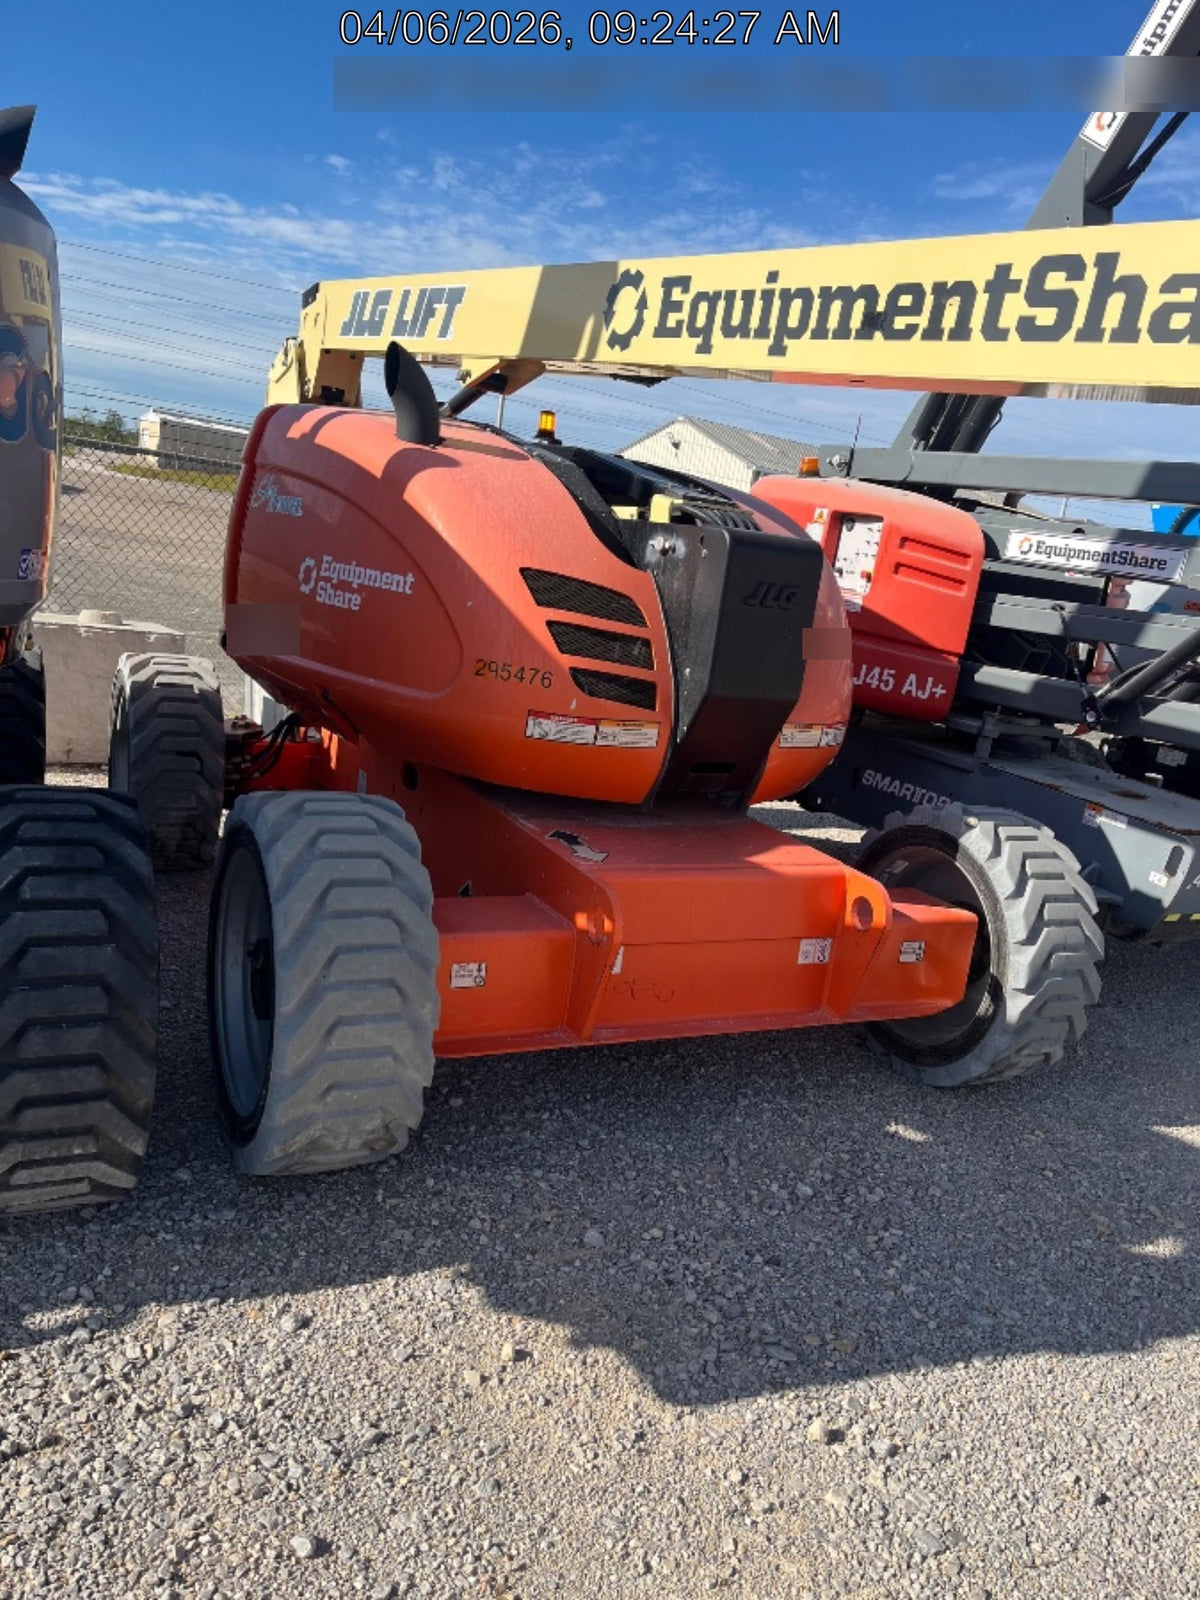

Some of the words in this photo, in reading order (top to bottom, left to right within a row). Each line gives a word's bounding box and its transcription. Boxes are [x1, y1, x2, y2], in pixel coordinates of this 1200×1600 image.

[339, 288, 394, 337] JLG
[390, 284, 468, 340] LIFT
[1034, 540, 1168, 571] EquipmentShare
[319, 553, 415, 595] Equipment
[315, 580, 362, 611] Share
[474, 658, 554, 689] 295476
[900, 672, 947, 700] AJ+
